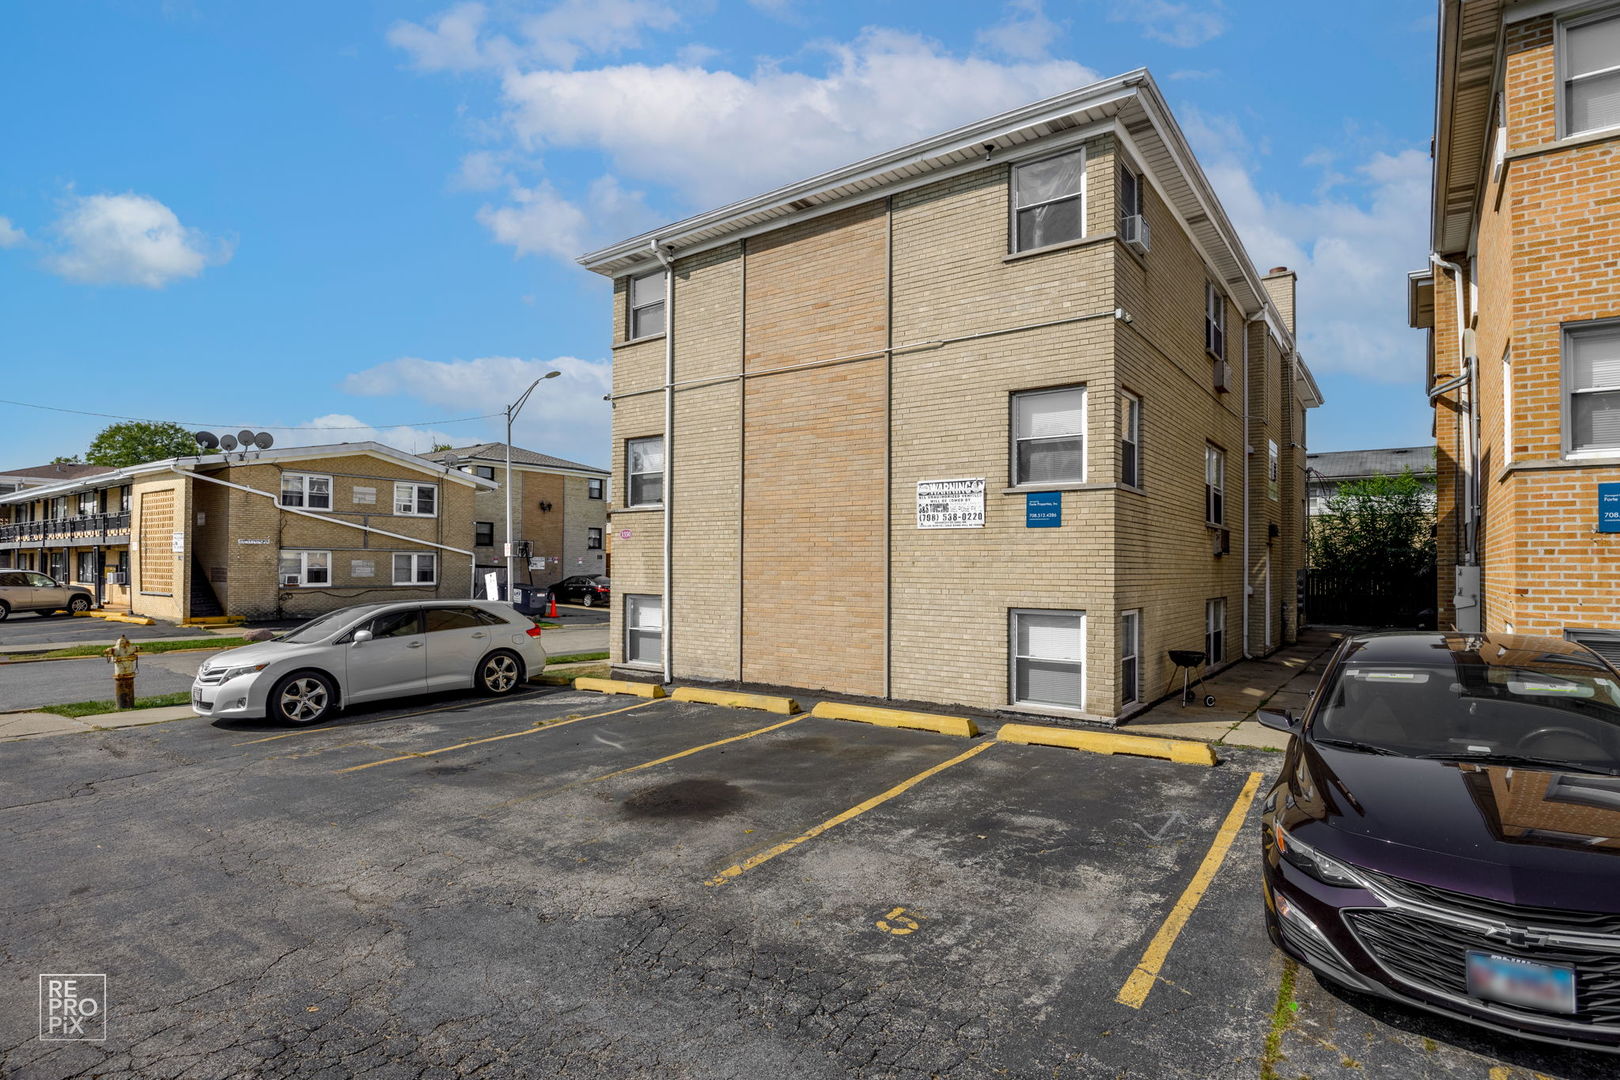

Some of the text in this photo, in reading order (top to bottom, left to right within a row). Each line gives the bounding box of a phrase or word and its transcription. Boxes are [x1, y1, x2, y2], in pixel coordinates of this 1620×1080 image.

[930, 481, 972, 495] WARNING
[919, 512, 982, 521] (708) 538-0220
